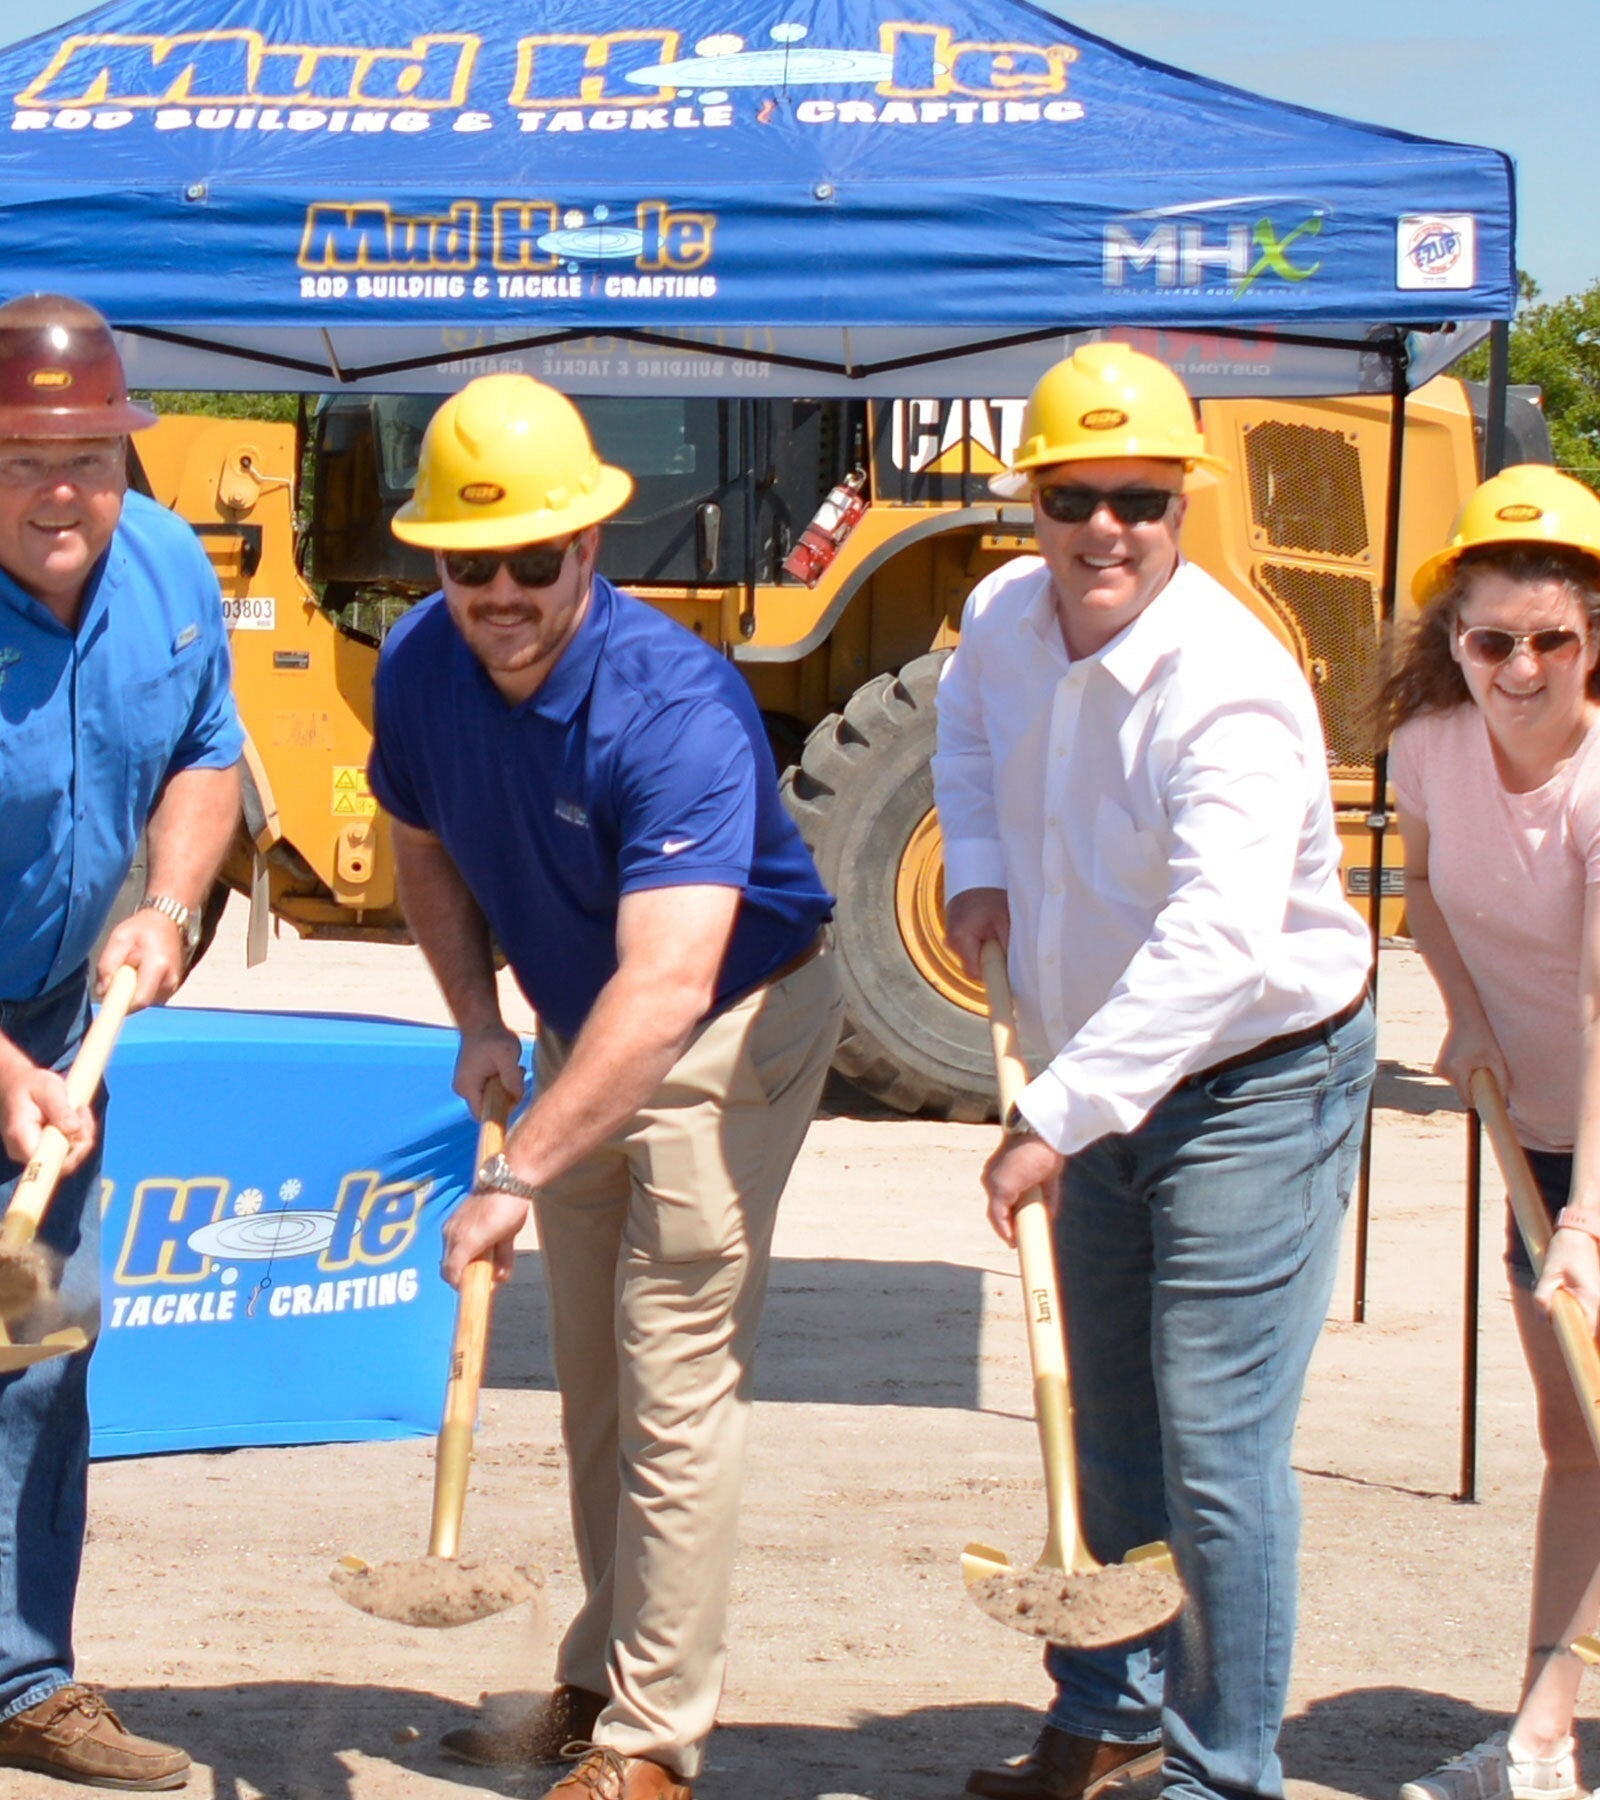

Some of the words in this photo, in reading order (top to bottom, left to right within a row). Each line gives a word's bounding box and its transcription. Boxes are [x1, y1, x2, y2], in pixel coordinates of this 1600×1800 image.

[14, 28, 481, 107] Mud
[11, 109, 134, 130] ROD
[155, 109, 431, 132] BUILDING
[452, 112, 492, 131] &
[516, 105, 733, 132] TACKLE
[796, 100, 1085, 124] CRAFTING
[297, 201, 478, 271] Mud
[1102, 217, 1323, 302] MHX
[300, 276, 348, 299] ROD
[356, 276, 466, 299] BUILDING
[472, 276, 490, 299] &
[496, 276, 582, 299] TACKLE
[604, 276, 718, 299] CRAFTING
[892, 399, 1027, 473] CAT
[222, 600, 272, 618] 03803
[109, 1289, 237, 1328] TACKLE
[268, 1268, 419, 1317] CRAFTING
[1032, 1289, 1052, 1324] Anvil
